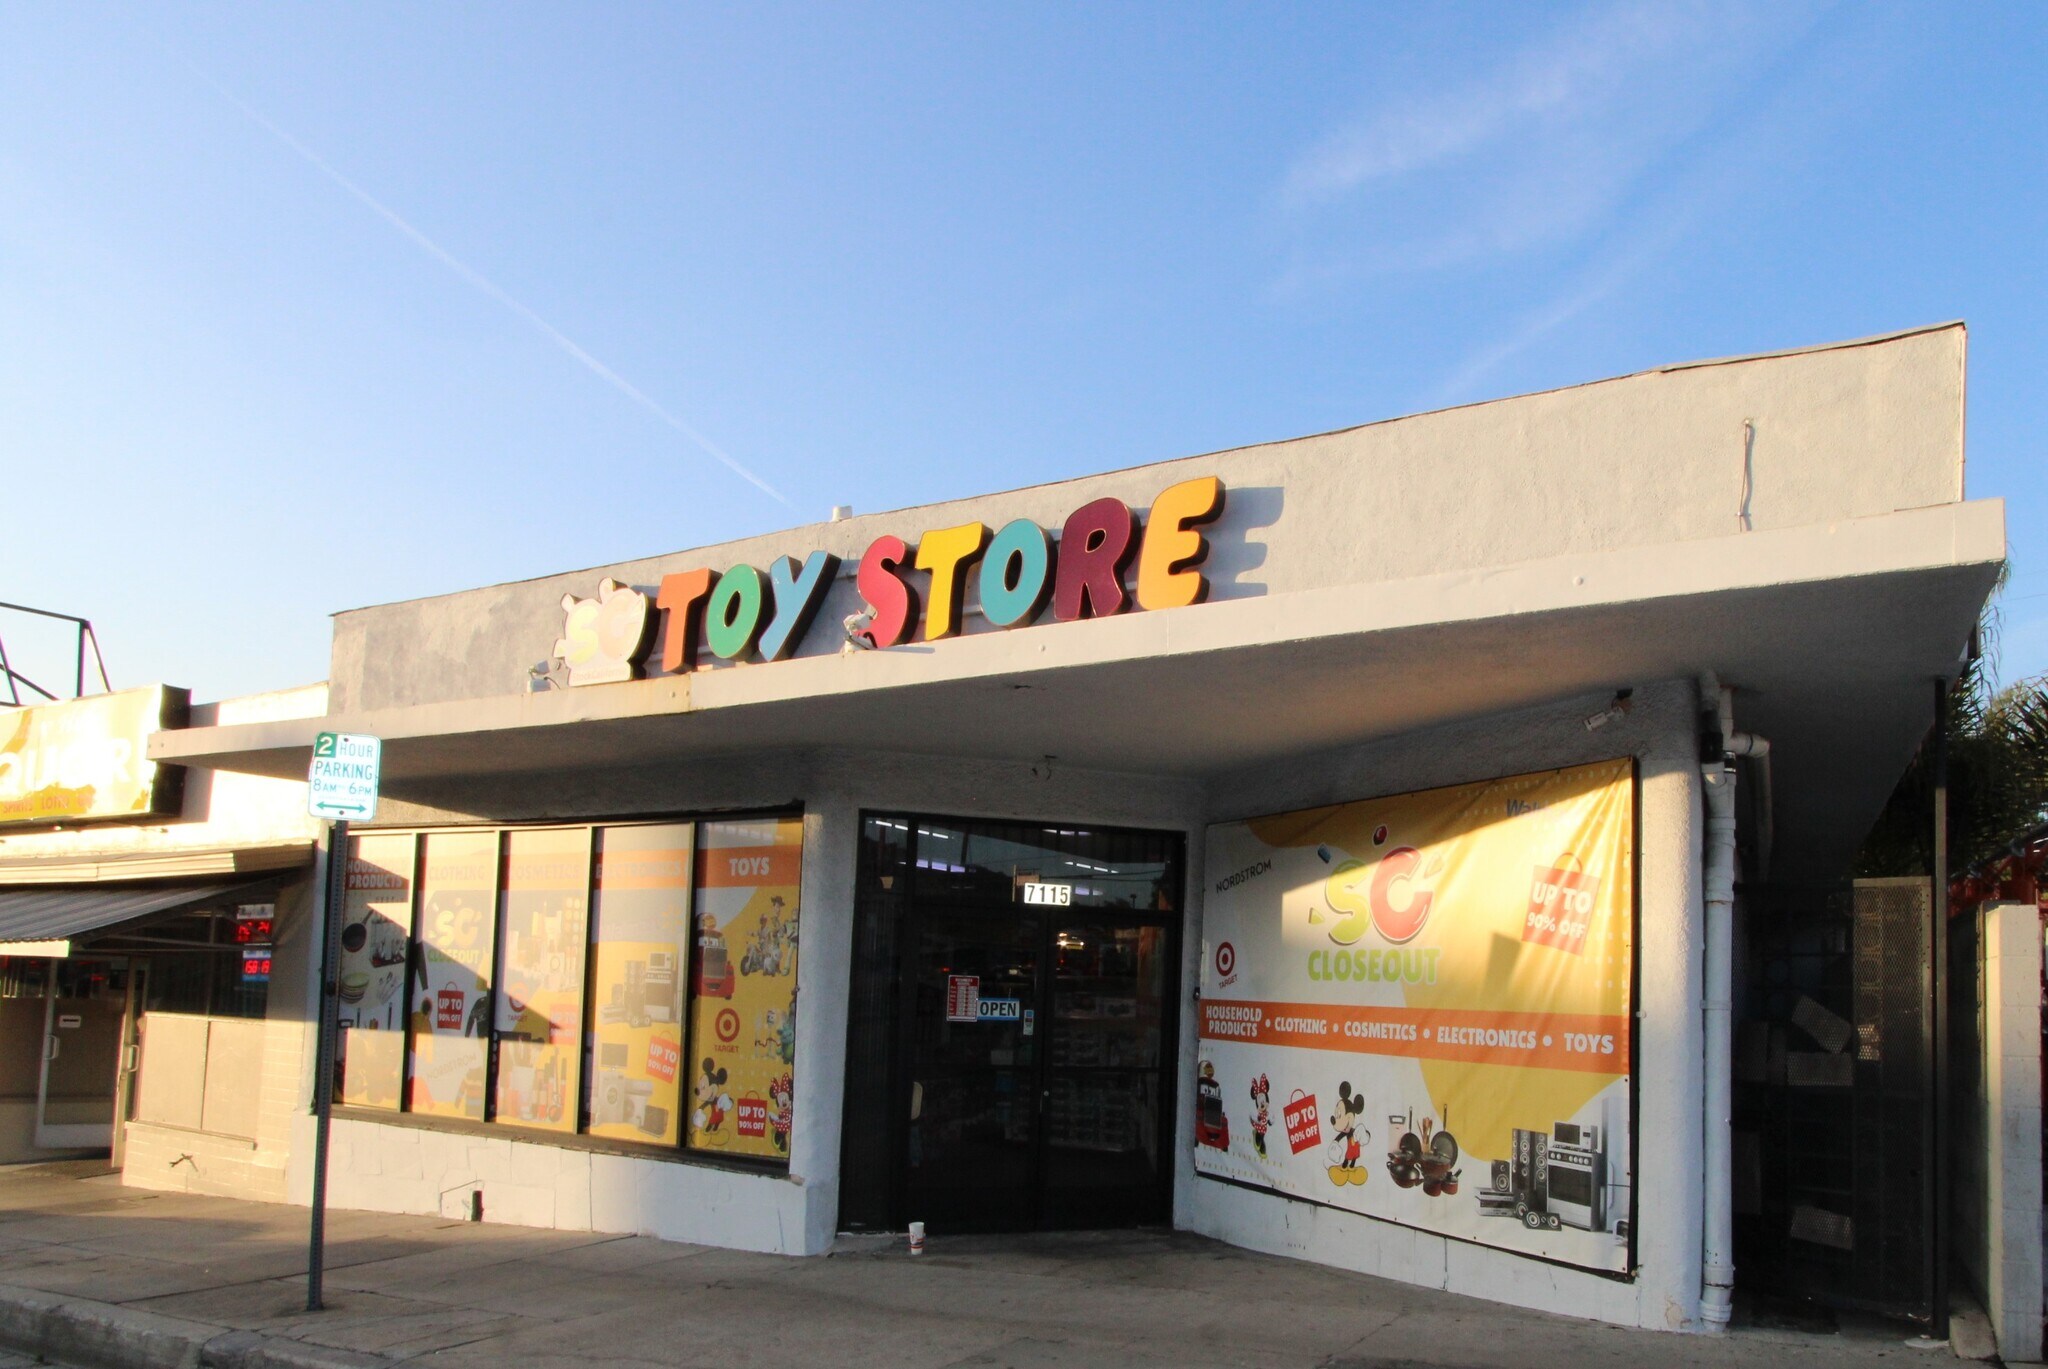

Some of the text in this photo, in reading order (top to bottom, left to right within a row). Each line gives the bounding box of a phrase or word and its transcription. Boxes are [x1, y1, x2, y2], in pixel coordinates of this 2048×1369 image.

[656, 474, 1222, 673] TOY STORE
[318, 736, 373, 758] 2 HOUR
[315, 760, 373, 780] PARKING
[728, 856, 770, 877] TOYS
[1215, 859, 1272, 893] NORDSTROM
[349, 873, 402, 889] PRODUCTS
[1027, 884, 1069, 905] 7115
[1324, 846, 1434, 945] SC
[1532, 880, 1592, 914] UP TO
[1526, 912, 1586, 938] 90% OFF
[1307, 949, 1441, 984] CLOSEOUT
[1218, 974, 1238, 989] TARGET
[439, 997, 462, 1010] UP TO
[980, 1001, 1017, 1017] OPEN
[1206, 1005, 1263, 1023] HOUSEHOLD
[1208, 1019, 1258, 1037] PRODUCTS
[1274, 1017, 1615, 1055] CLOTHING COSMETICS ELECTRONICS TOYS
[650, 1042, 677, 1064] UP TO
[714, 1044, 739, 1054] TARGET
[738, 1106, 765, 1119] UP TO
[1286, 1105, 1316, 1129] UP TO
[753, 1121, 764, 1130] OFF
[1290, 1124, 1318, 1145] 90% OFF
